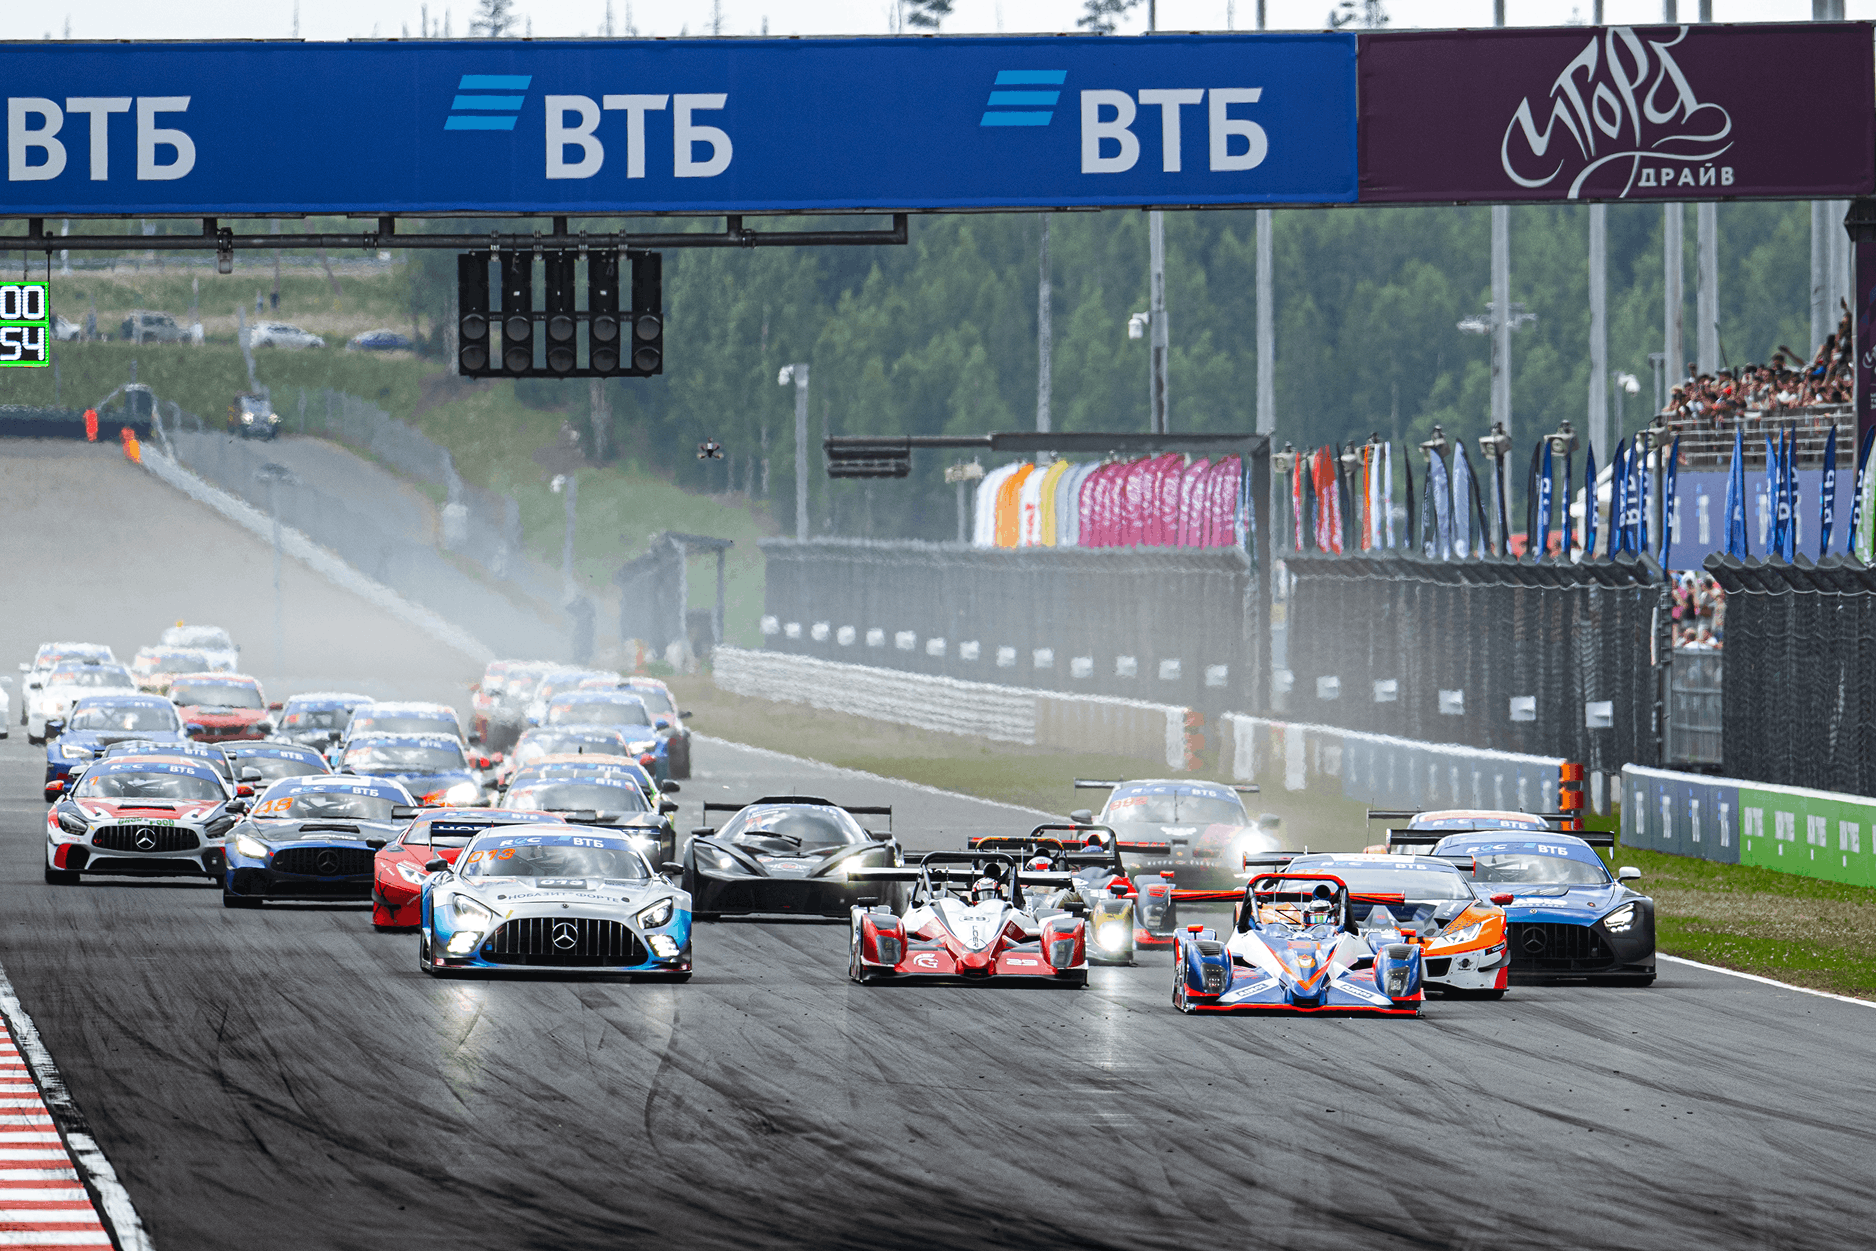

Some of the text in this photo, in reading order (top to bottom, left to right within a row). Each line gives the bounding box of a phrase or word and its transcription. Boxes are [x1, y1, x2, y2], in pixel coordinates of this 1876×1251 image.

[8, 97, 196, 181] ВТБ
[545, 94, 733, 178] ВТБ
[1081, 88, 1268, 173] ВТБ
[1637, 163, 1735, 187] ДРАЙВ
[0, 285, 45, 320] 00
[0, 326, 45, 361] 54
[170, 765, 196, 775] ВТБ
[352, 786, 380, 797] ВТБ
[253, 797, 294, 815] 48
[1500, 820, 1529, 830] ВТБ
[573, 837, 605, 848] ВТБ
[1537, 844, 1569, 856] ВТБ
[467, 848, 516, 864] 013
